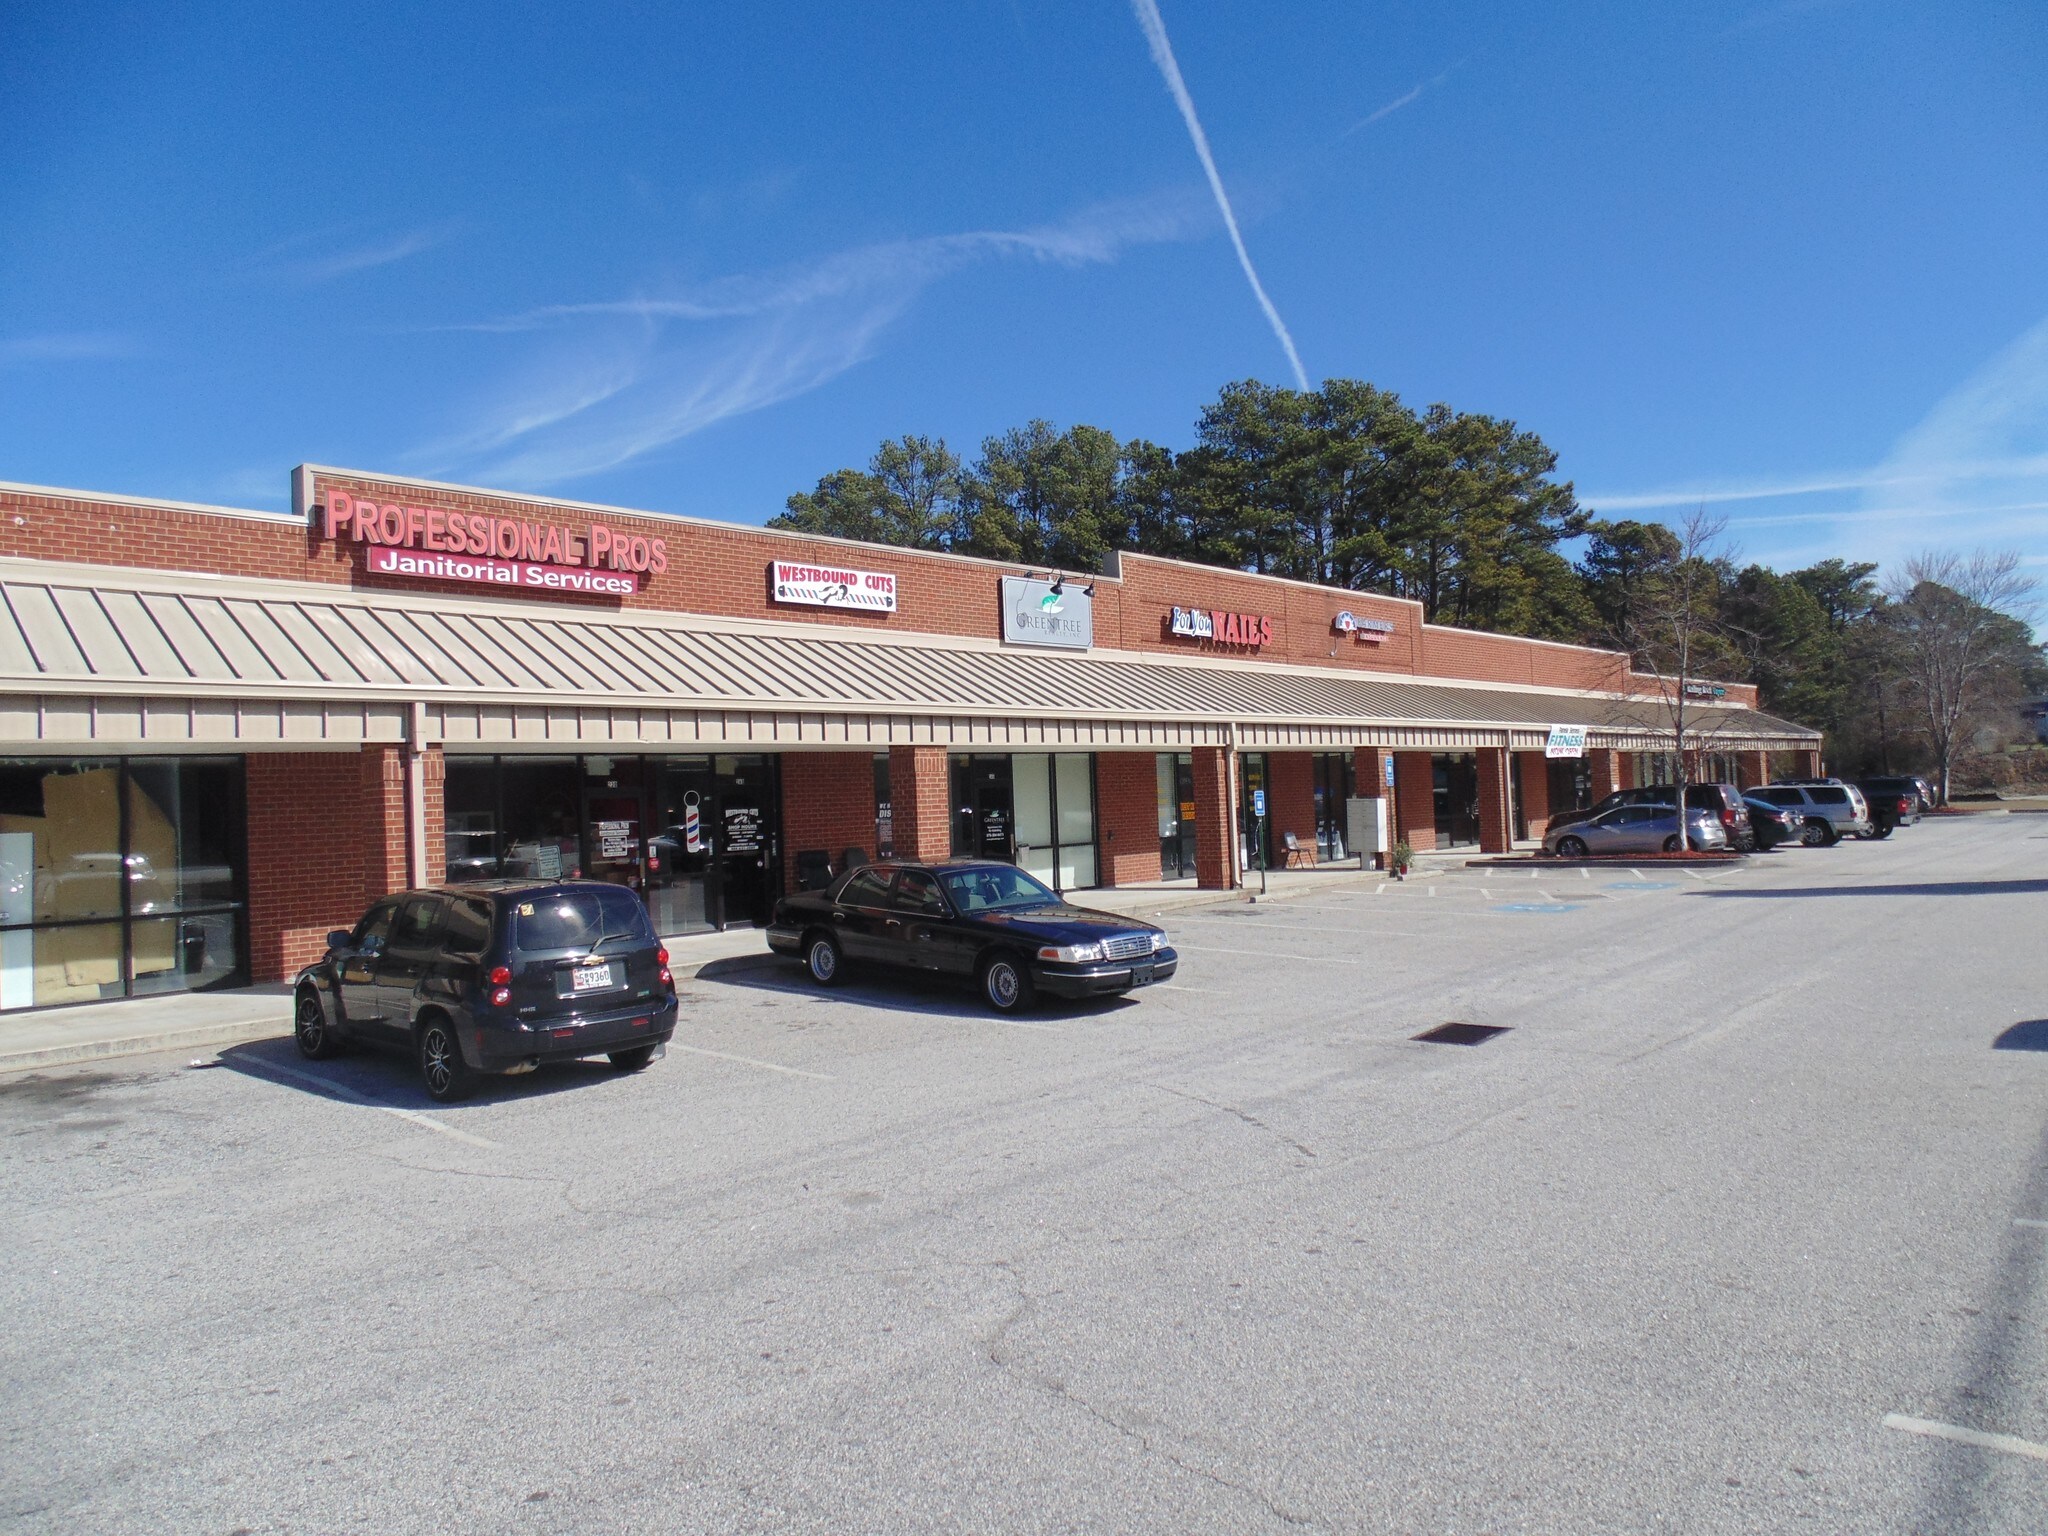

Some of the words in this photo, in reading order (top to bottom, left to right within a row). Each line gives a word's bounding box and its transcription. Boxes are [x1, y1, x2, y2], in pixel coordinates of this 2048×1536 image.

[325, 490, 581, 565] PROFESSIONAL
[588, 525, 667, 574] PROS
[379, 551, 519, 583] Janitorial
[525, 566, 633, 593] Services
[778, 565, 858, 586] WESTBOUND
[865, 575, 893, 594] CUTS
[1211, 611, 1272, 646] NAILS
[1549, 734, 1584, 746] FITNESS
